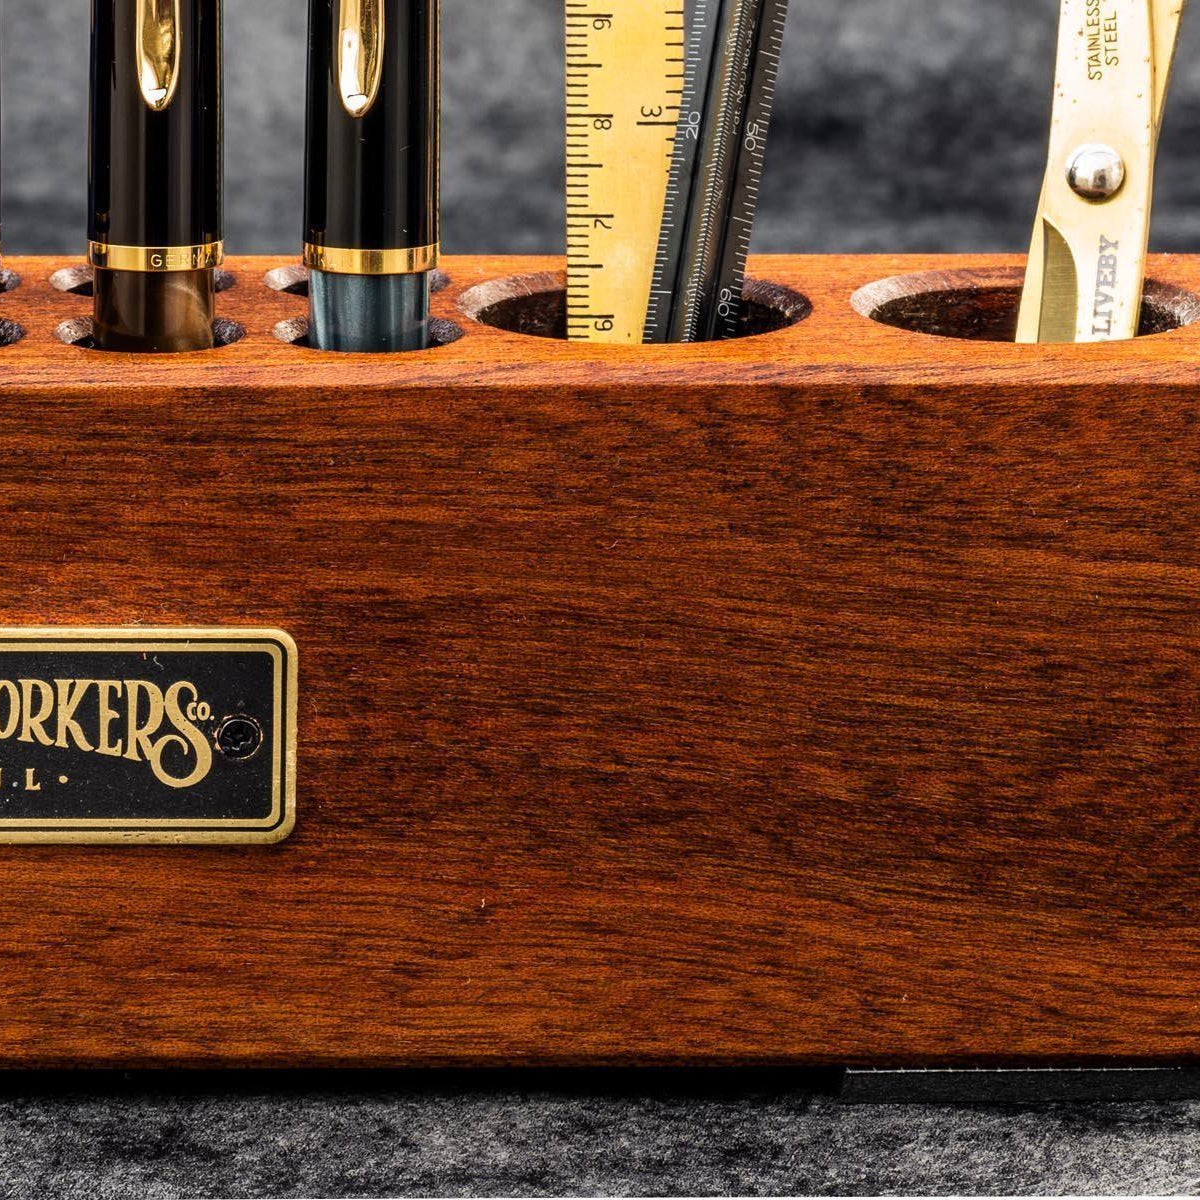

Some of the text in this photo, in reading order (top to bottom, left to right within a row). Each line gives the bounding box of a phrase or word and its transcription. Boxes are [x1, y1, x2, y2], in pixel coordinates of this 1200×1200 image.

[593, 19, 611, 30] 9
[1105, 11, 1119, 66] STEEL
[641, 106, 662, 117] 3
[594, 119, 612, 130] 8
[686, 112, 700, 139] 20
[745, 123, 759, 150] 50
[594, 219, 612, 229] 7
[1092, 234, 1119, 336] LIVEBY
[718, 289, 732, 316] 60
[594, 320, 613, 331] 6
